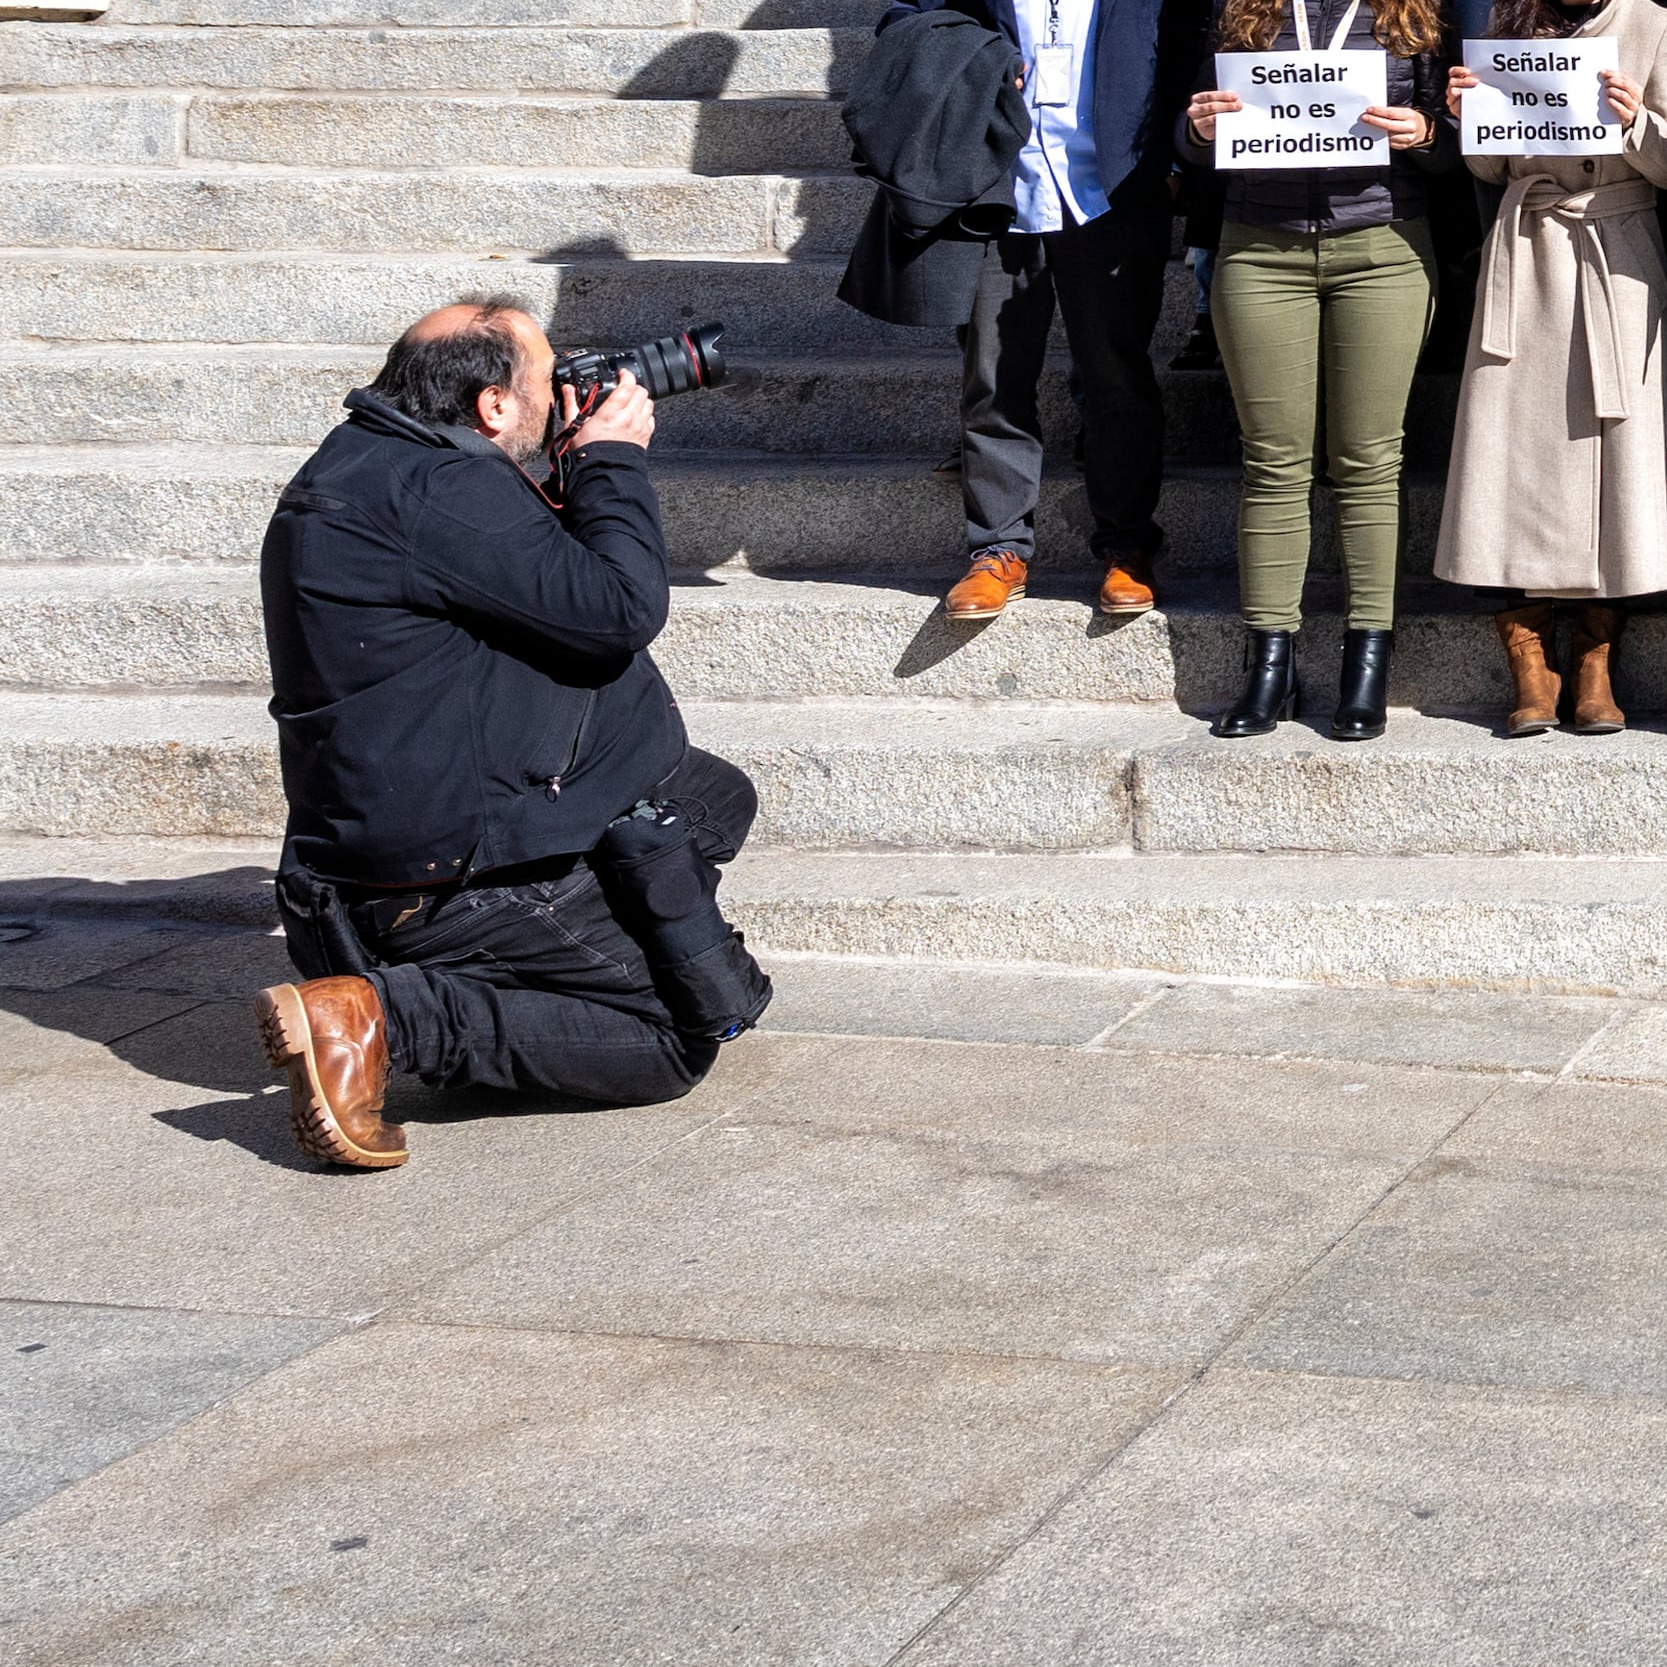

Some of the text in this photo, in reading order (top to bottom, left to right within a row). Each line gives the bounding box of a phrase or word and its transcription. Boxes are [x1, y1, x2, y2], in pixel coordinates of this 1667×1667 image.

[1492, 51, 1581, 73] Señalar
[1251, 62, 1348, 85] Señalar
[1511, 91, 1569, 108] no es
[1270, 103, 1336, 119] no es
[1476, 120, 1607, 145] periodismo
[1232, 133, 1374, 158] periodismo
